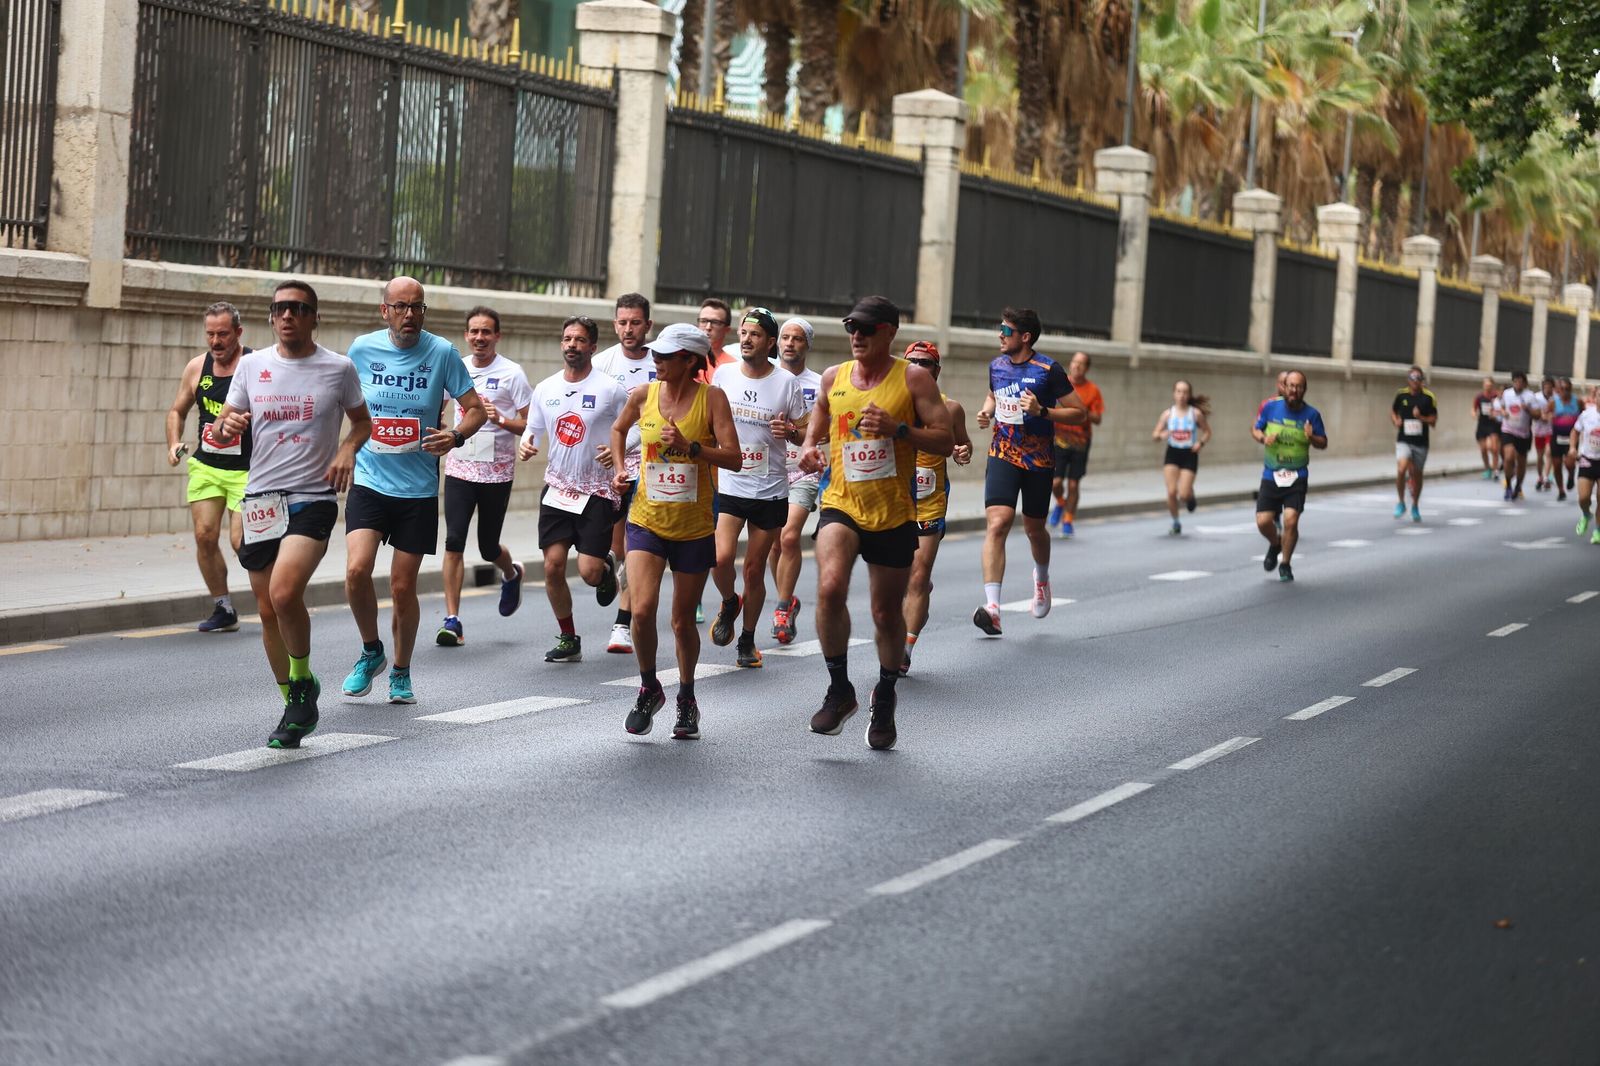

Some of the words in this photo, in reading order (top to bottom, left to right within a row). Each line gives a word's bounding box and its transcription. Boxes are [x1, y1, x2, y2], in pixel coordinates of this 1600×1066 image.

[371, 371, 428, 393] nerja
[376, 390, 421, 401] ATLETISMO
[730, 406, 776, 422] ARBELLA
[377, 425, 414, 437] 2468
[850, 449, 887, 462] 1022
[658, 473, 686, 484] 143
[917, 476, 930, 485] 61
[246, 507, 276, 523] 1034
